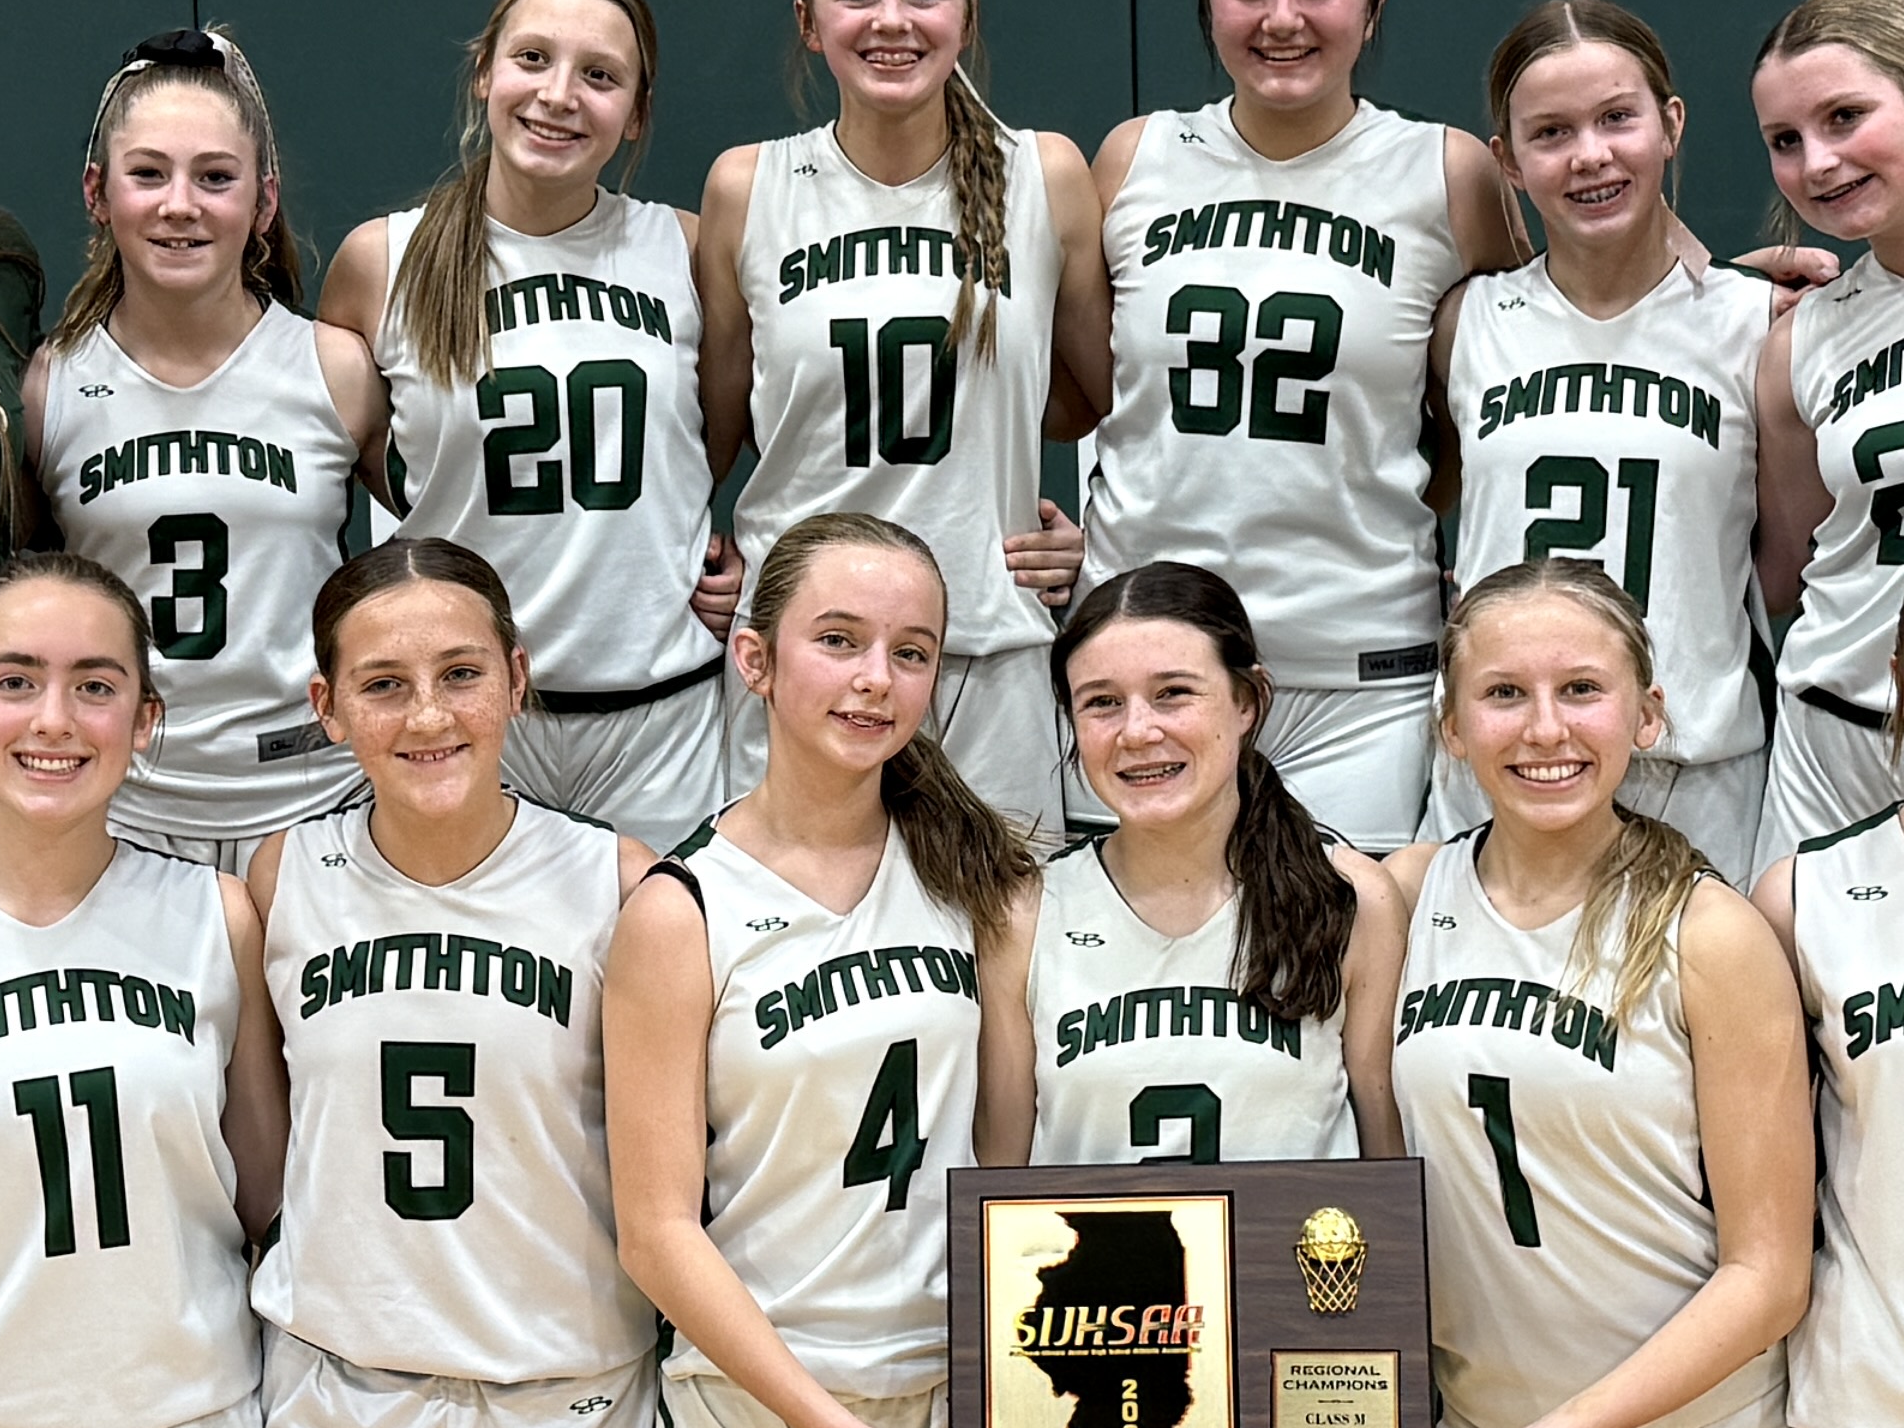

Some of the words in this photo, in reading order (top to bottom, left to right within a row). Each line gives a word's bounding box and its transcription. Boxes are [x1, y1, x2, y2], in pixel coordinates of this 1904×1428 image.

[1142, 199, 1396, 289] SMITHTON
[484, 272, 674, 345] ITHTON
[829, 315, 958, 468] 10
[1166, 284, 1344, 446] 32
[1477, 362, 1721, 451] SMITHTON
[78, 429, 298, 505] SMITHTON
[476, 359, 648, 517] 20
[1524, 454, 1660, 619] 21
[147, 512, 229, 660] 3
[299, 933, 573, 1029] SMITHTON
[755, 945, 981, 1051] SMITHTON
[1056, 985, 1302, 1069] SMITHTON
[1396, 977, 1619, 1074] SMITHTON
[13, 1065, 131, 1258] 11
[380, 1041, 477, 1221] 5
[842, 1037, 928, 1213] 4
[1467, 1073, 1541, 1249] 1
[1011, 1303, 1205, 1350] SIJHSAA
[1290, 1365, 1381, 1376] REGIONAL
[1283, 1379, 1388, 1391] CHAMPIONS
[1305, 1413, 1350, 1426] CLASS
[1353, 1413, 1366, 1425] M
